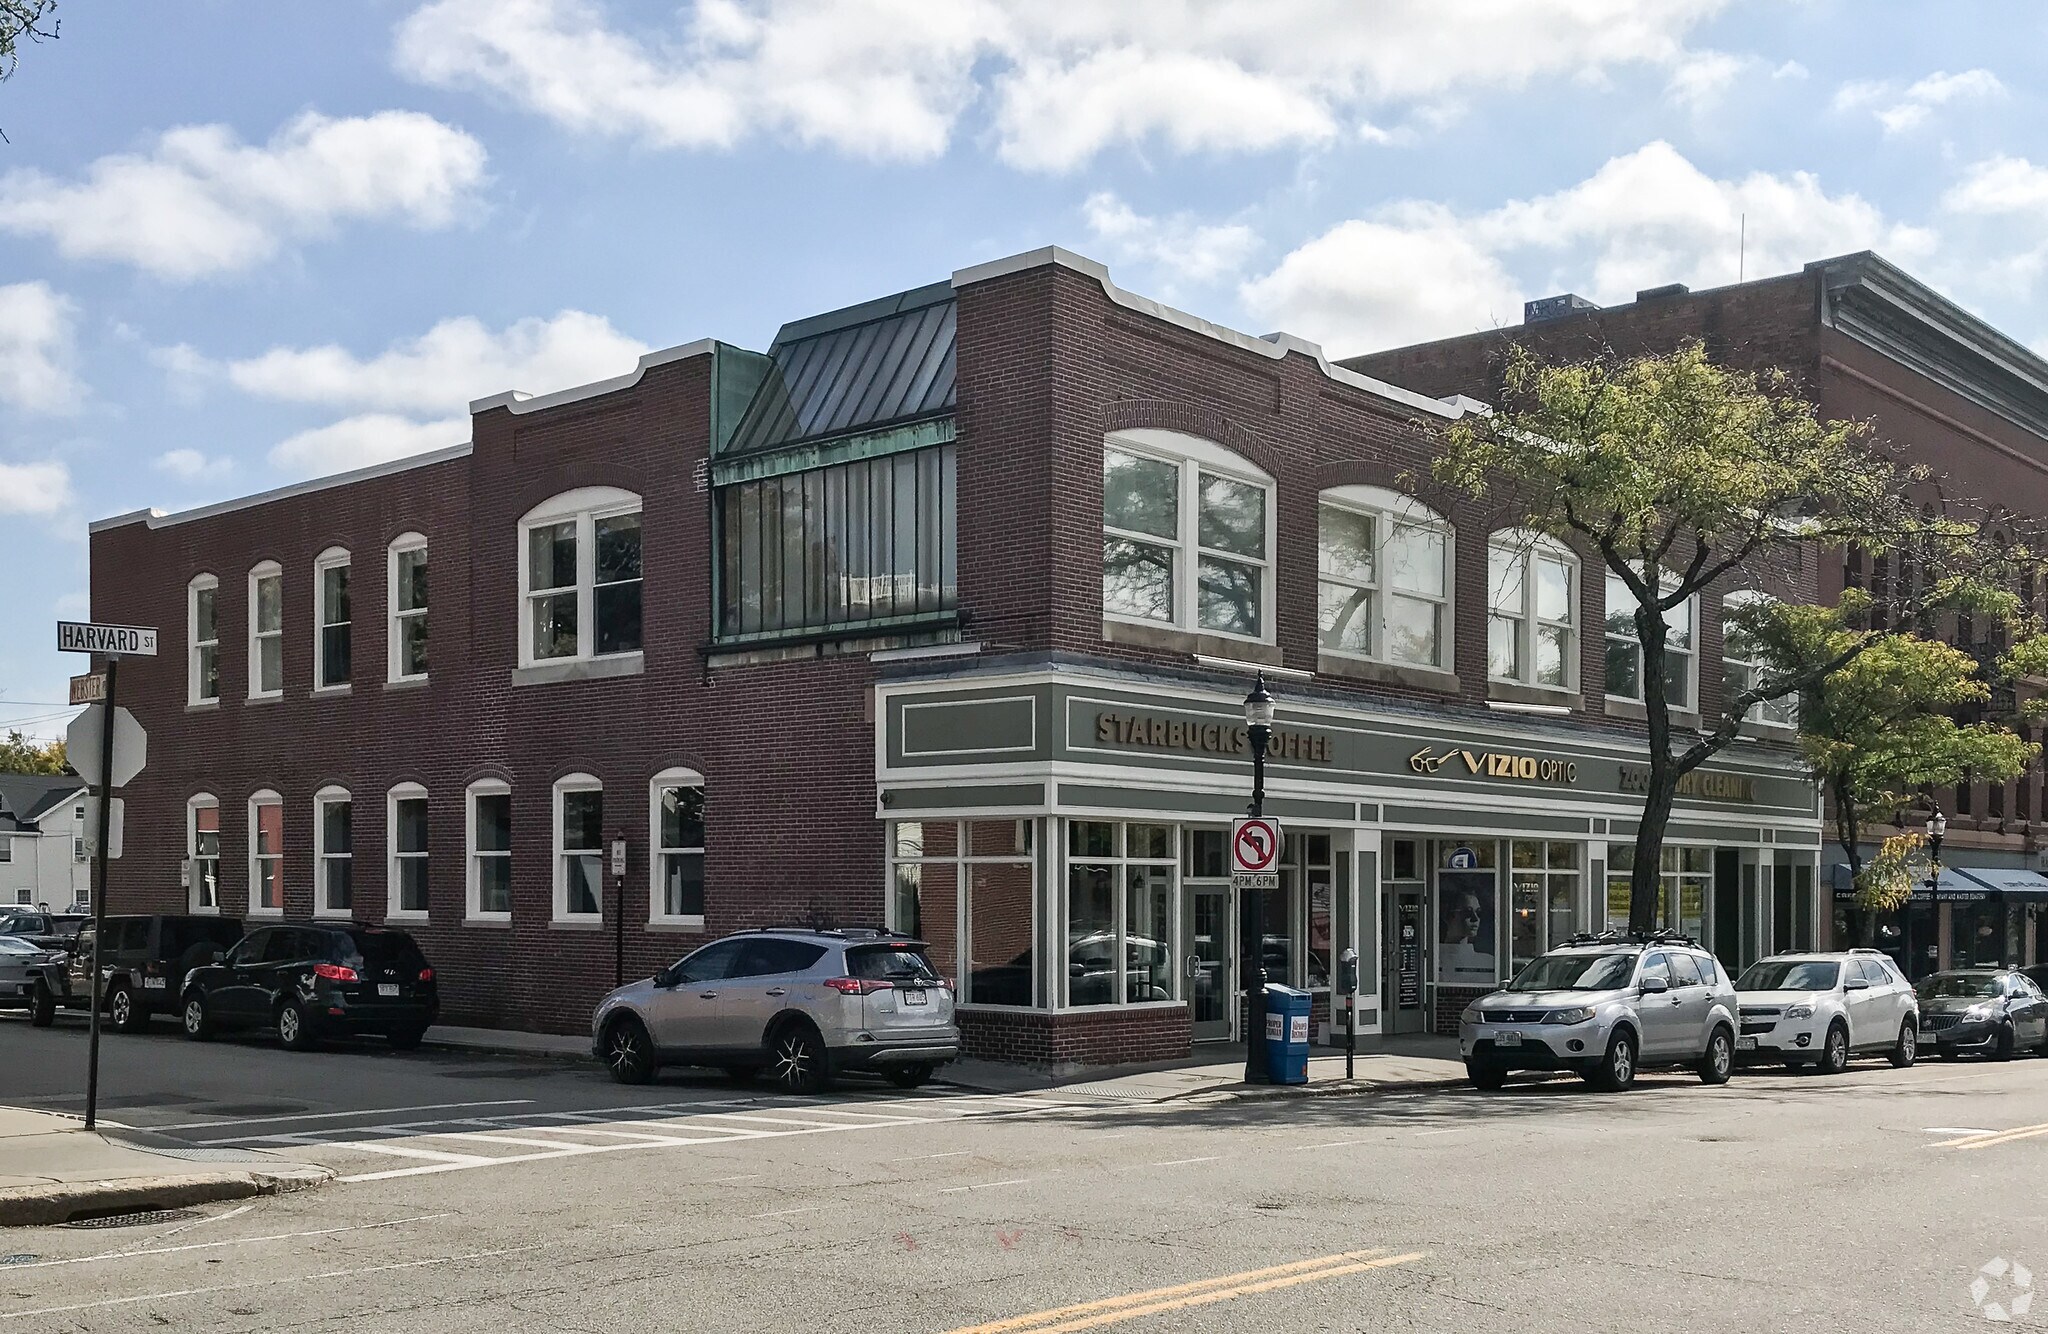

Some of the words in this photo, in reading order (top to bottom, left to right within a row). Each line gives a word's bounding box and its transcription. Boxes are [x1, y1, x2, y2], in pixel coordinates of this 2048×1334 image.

[63, 625, 139, 651] HARVARD
[144, 636, 154, 648] ST
[1097, 711, 1250, 754] STARBUCKS
[1267, 729, 1334, 762] OFFEE
[1461, 750, 1538, 779] VIZIO
[1540, 758, 1577, 783] OPTIC
[1232, 875, 1252, 887] 4PM
[1256, 875, 1276, 887] 6PM
